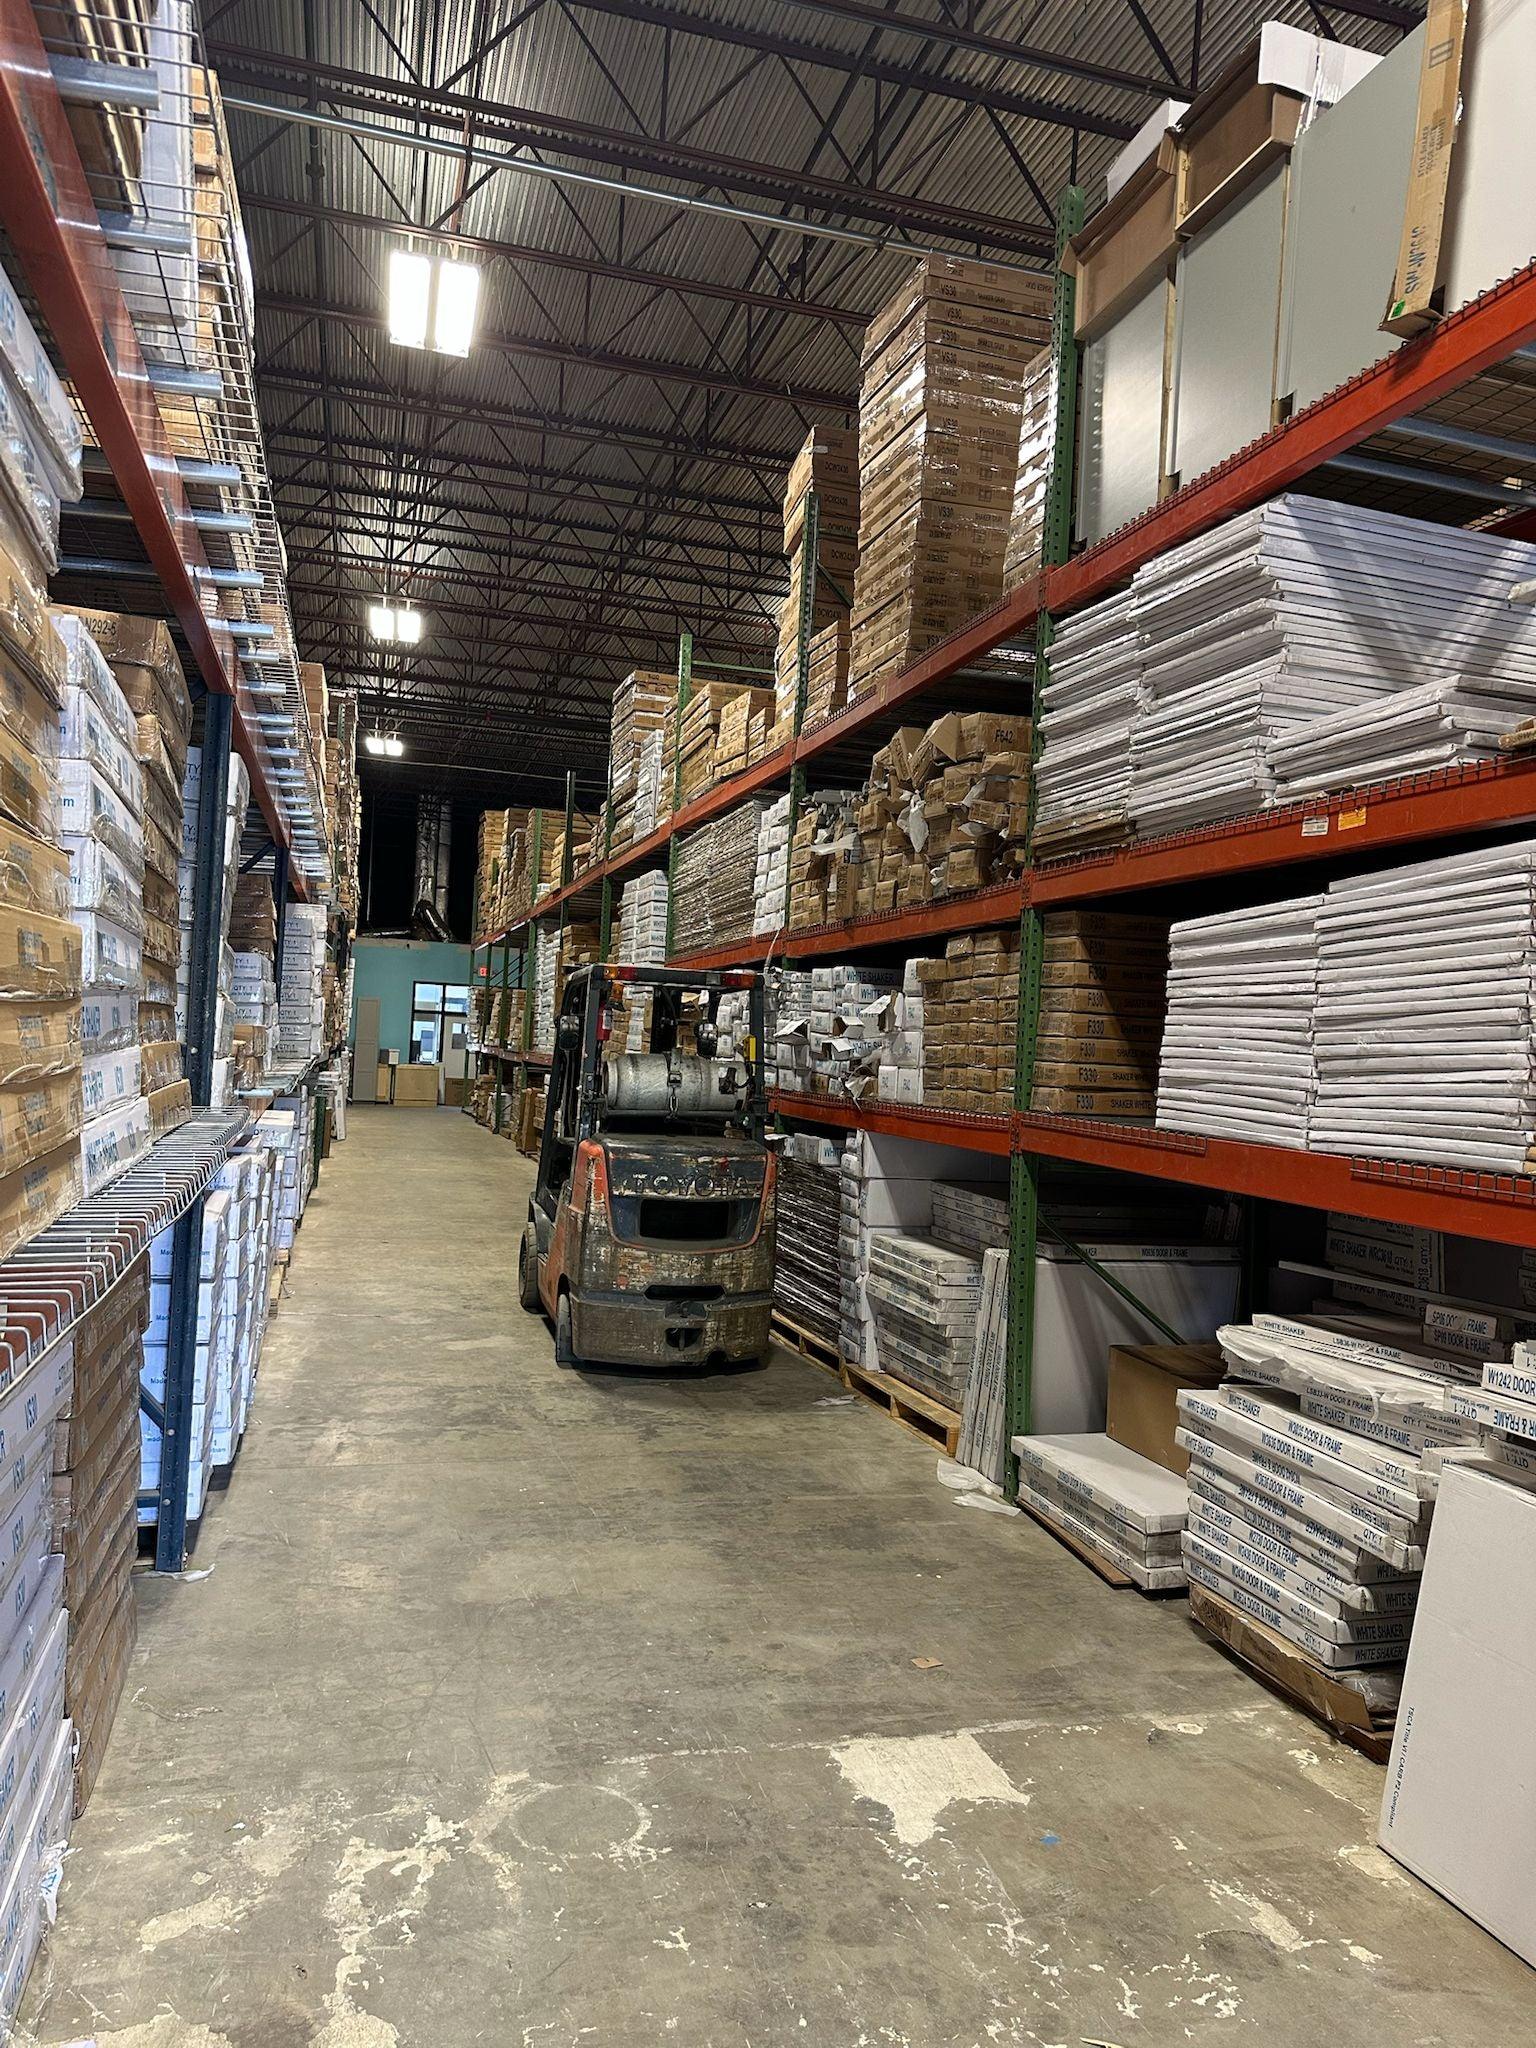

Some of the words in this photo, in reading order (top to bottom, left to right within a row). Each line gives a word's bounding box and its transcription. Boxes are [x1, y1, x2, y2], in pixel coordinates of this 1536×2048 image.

[1087, 1019, 1104, 1035] F330
[1080, 1042, 1096, 1057] F330
[1079, 1067, 1098, 1082] F330
[1111, 1072, 1133, 1081] SHAKER
[1076, 1094, 1094, 1109] F330
[1111, 1099, 1133, 1109] SHAKER
[1134, 1100, 1152, 1109] WHITE
[632, 1173, 749, 1197] TOYOTA
[1467, 1318, 1488, 1335] FRAME
[1264, 1321, 1281, 1331] WHITE
[1282, 1324, 1306, 1336] SHAKER
[1380, 1348, 1402, 1360] FRAME
[1447, 1332, 1464, 1348] DOOR
[1470, 1338, 1491, 1355] FRAME
[1242, 1367, 1259, 1379] WHITE
[1259, 1372, 1281, 1384] SHAKER
[1488, 1367, 1512, 1390] W1242
[1512, 1376, 1536, 1397] DOOR
[1329, 1392, 1345, 1404] DOOR
[1352, 1401, 1373, 1413] FRAME
[1403, 1415, 1416, 1425] QTY:
[1459, 1405, 1477, 1420] QTY:
[1494, 1409, 1520, 1433] FRAME
[1522, 1418, 1528, 1434] &
[1227, 1394, 1244, 1410] WHITE
[1244, 1400, 1261, 1417] SHAKER
[1303, 1425, 1319, 1444] DOOR
[1322, 1435, 1342, 1454] FRAME
[1384, 1462, 1400, 1474] QTY:
[1308, 1402, 1326, 1416] WHITE
[1326, 1407, 1345, 1422] SHAKER
[1366, 1420, 1383, 1436] DOOR
[1389, 1428, 1411, 1447] FRAME
[1186, 1400, 1202, 1415] WHITE
[1201, 1405, 1218, 1422] SHAKER
[1276, 1438, 1291, 1456] DOOR
[1296, 1447, 1314, 1468] FRAME
[1376, 1485, 1390, 1497] QTY:
[1511, 1454, 1529, 1469] QTY:
[1185, 1436, 1198, 1451] WHITE
[1198, 1441, 1215, 1458] SHAKER
[1268, 1477, 1283, 1494] DOOR
[1287, 1488, 1305, 1508] FRAME
[1363, 1528, 1378, 1540] QTY:
[1201, 1502, 1215, 1520] WHITE
[1214, 1509, 1233, 1528] SHAKER
[1262, 1535, 1277, 1553] DOOR
[1281, 1547, 1299, 1568] FRAME
[1305, 1519, 1326, 1542] SHAKER
[1326, 1530, 1344, 1551] WHITE
[1199, 1519, 1211, 1535] WHITE
[1211, 1527, 1229, 1546] SHAKER
[1251, 1549, 1266, 1566] DOOR
[1269, 1560, 1286, 1582] FRAME
[1304, 1581, 1318, 1592] QTY:
[1191, 1541, 1205, 1558] WHITE
[1205, 1548, 1222, 1568] SHAKER
[1245, 1570, 1260, 1589] DOOR
[1263, 1581, 1281, 1603] FRAME
[1298, 1603, 1312, 1615] QTY:
[1190, 1561, 1203, 1579] WHITE
[1203, 1571, 1220, 1589] SHAKER
[1246, 1596, 1260, 1613] DOOR
[1264, 1608, 1281, 1629] FRAME
[1304, 1632, 1317, 1643] QTY:
[1386, 1592, 1407, 1608] WHITE
[1356, 1625, 1377, 1640] WHITE
[1377, 1623, 1404, 1639] SHAKER
[1354, 1648, 1376, 1660] WHITE
[1377, 1646, 1403, 1659] SHAKER
[1406, 1705, 1415, 1726] TSCA
[1403, 1727, 1411, 1743] Title
[1401, 1745, 1408, 1754] VI
[1397, 1757, 1406, 1779] CARB
[1395, 1779, 1401, 1791] P2
[1388, 1790, 1400, 1828] Compliant
